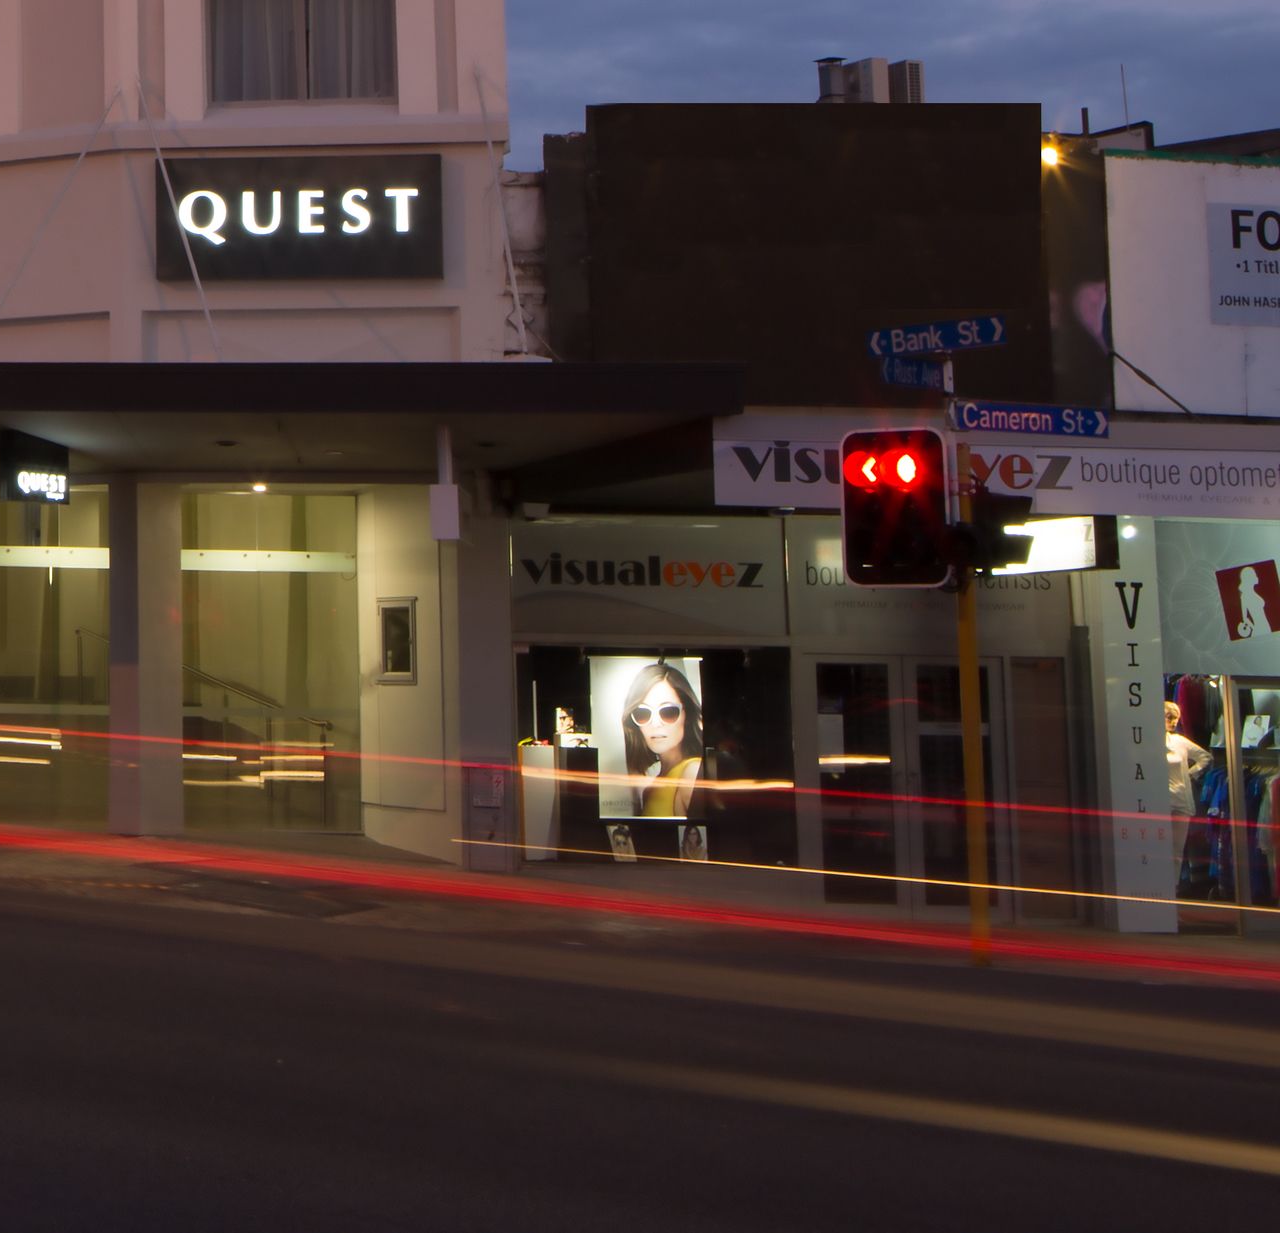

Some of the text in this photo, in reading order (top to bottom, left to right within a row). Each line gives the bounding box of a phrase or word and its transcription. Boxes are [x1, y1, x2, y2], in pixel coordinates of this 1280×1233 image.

[179, 189, 419, 245] QUEST
[1219, 295, 1250, 307] JOHN
[891, 320, 981, 352] Bank St
[894, 358, 918, 384] Rust
[962, 402, 1085, 434] Cameron St
[17, 471, 67, 494] QUEST
[1080, 456, 1180, 489] boutique
[1190, 460, 1280, 492] optome
[520, 552, 764, 588] visualeyez
[1114, 581, 1146, 814] VISUAL
